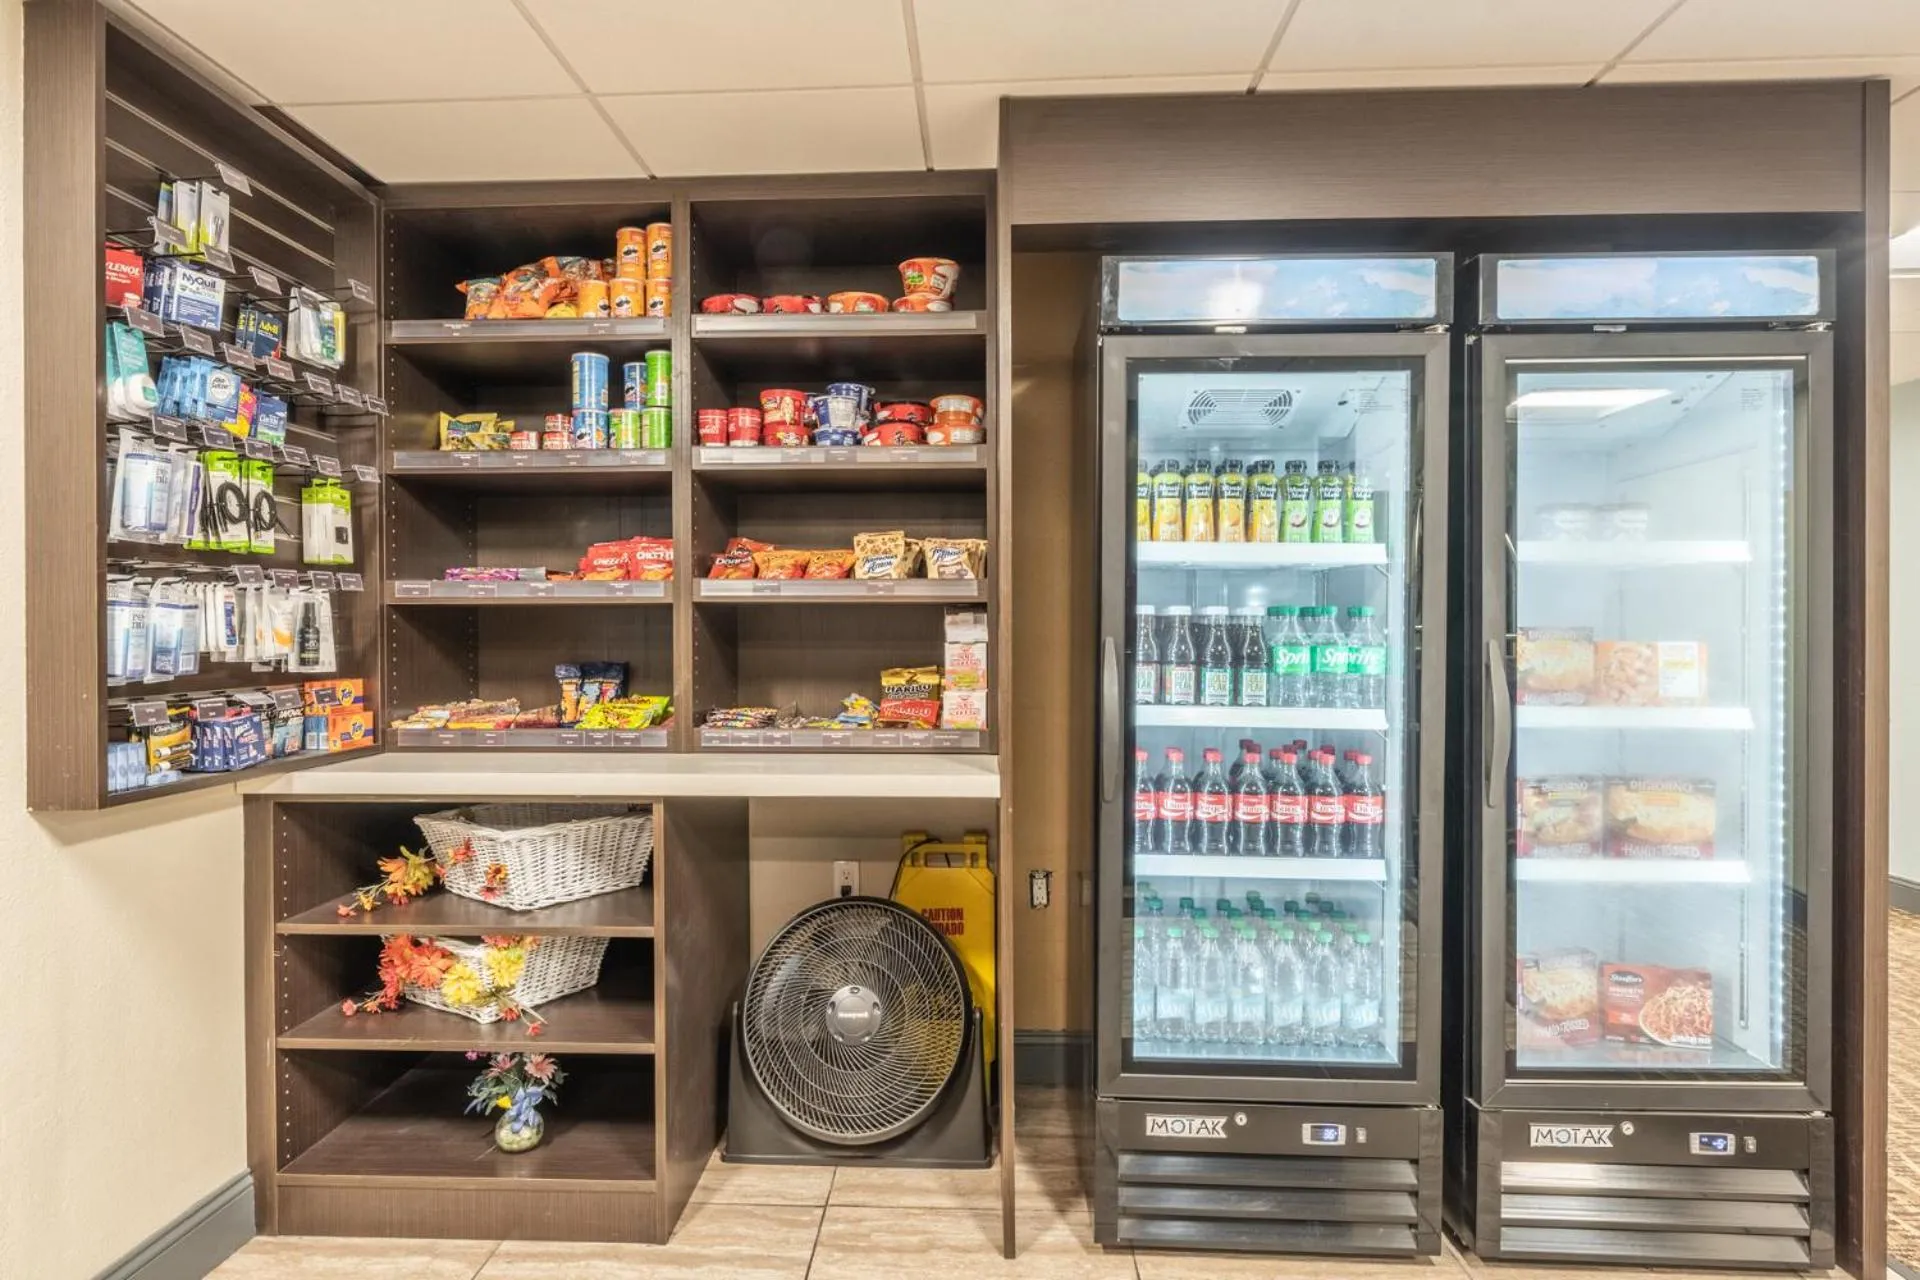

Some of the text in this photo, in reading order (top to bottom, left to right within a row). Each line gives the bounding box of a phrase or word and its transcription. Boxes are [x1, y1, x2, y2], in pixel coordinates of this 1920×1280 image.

[182, 272, 217, 289] NyQuil
[921, 907, 964, 921] CAUTION
[1150, 1118, 1221, 1135] MOTAK
[1535, 1128, 1608, 1144] MOTAK
